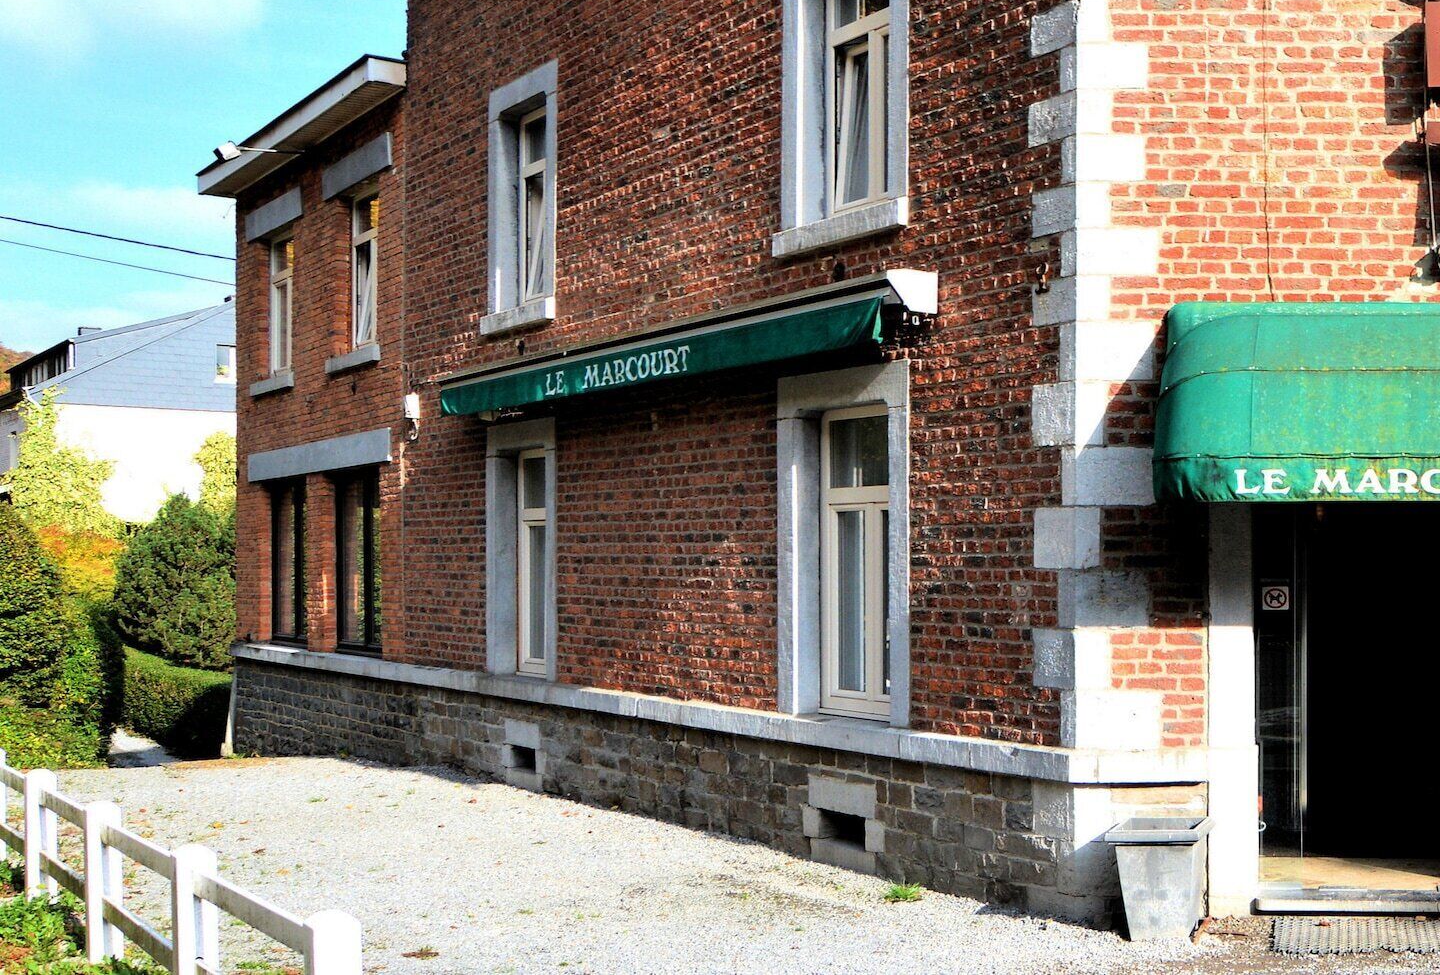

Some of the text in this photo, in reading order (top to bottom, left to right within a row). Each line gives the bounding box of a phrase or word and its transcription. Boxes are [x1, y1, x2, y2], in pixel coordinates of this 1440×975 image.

[544, 345, 692, 396] LE MARCOURT
[1234, 468, 1290, 495] LE
